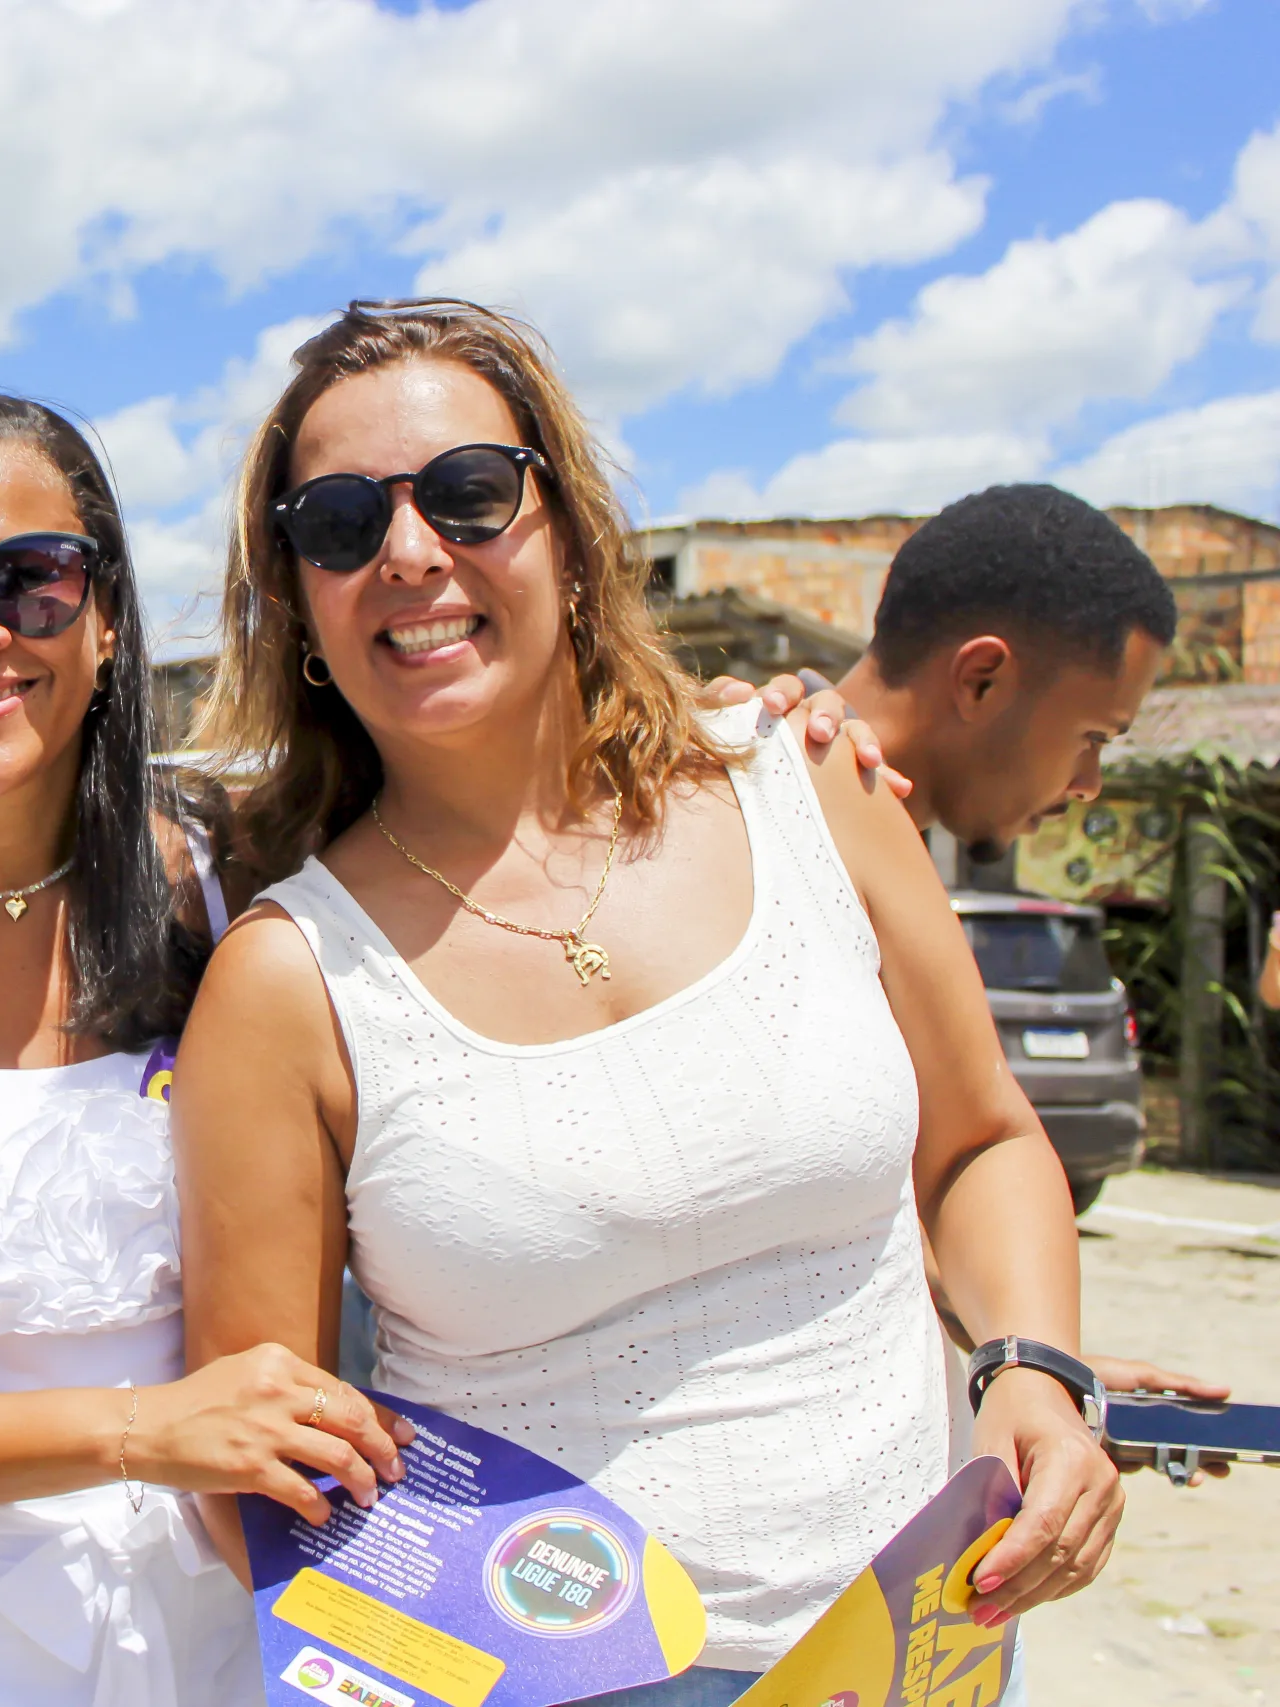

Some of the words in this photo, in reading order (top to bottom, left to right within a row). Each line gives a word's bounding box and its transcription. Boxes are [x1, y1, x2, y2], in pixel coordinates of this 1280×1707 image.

[435, 1451, 444, 1461] é
[447, 1443, 481, 1465] contra
[407, 1464, 439, 1484] humilhar
[439, 1481, 448, 1489] ou
[449, 1485, 469, 1498] bater
[421, 1459, 448, 1477] segurar
[449, 1473, 459, 1481] ou
[459, 1478, 480, 1493] beijar
[386, 1491, 397, 1500] ou
[397, 1496, 427, 1515] aprende
[393, 1481, 409, 1493] Não
[431, 1501, 443, 1510] Ou
[442, 1506, 473, 1526] aprende
[414, 1480, 434, 1494] crime
[434, 1491, 455, 1505] grave
[461, 1502, 483, 1518] pode
[378, 1517, 389, 1528] is
[388, 1523, 396, 1532] a
[384, 1533, 402, 1545] force
[394, 1510, 434, 1536] against
[298, 1543, 315, 1554] want
[315, 1551, 323, 1559] to
[323, 1556, 333, 1564] be
[333, 1559, 348, 1571] with
[315, 1540, 325, 1549] No
[326, 1546, 347, 1560] means
[365, 1565, 378, 1574] the
[377, 1572, 403, 1587] woman
[338, 1521, 375, 1543] humiliating
[375, 1539, 384, 1547] or
[407, 1554, 436, 1572] because
[338, 1542, 376, 1563] harassment
[376, 1560, 391, 1570] and
[389, 1567, 406, 1579] may
[406, 1574, 423, 1586] lead
[364, 1544, 380, 1556] your
[403, 1562, 414, 1571] All
[414, 1567, 423, 1576] of
[422, 1572, 436, 1582] this
[527, 1539, 610, 1590] DENUNCIE
[510, 1557, 562, 1593] LIGUE
[557, 1580, 593, 1610] 180.
[911, 1563, 944, 1624] ME
